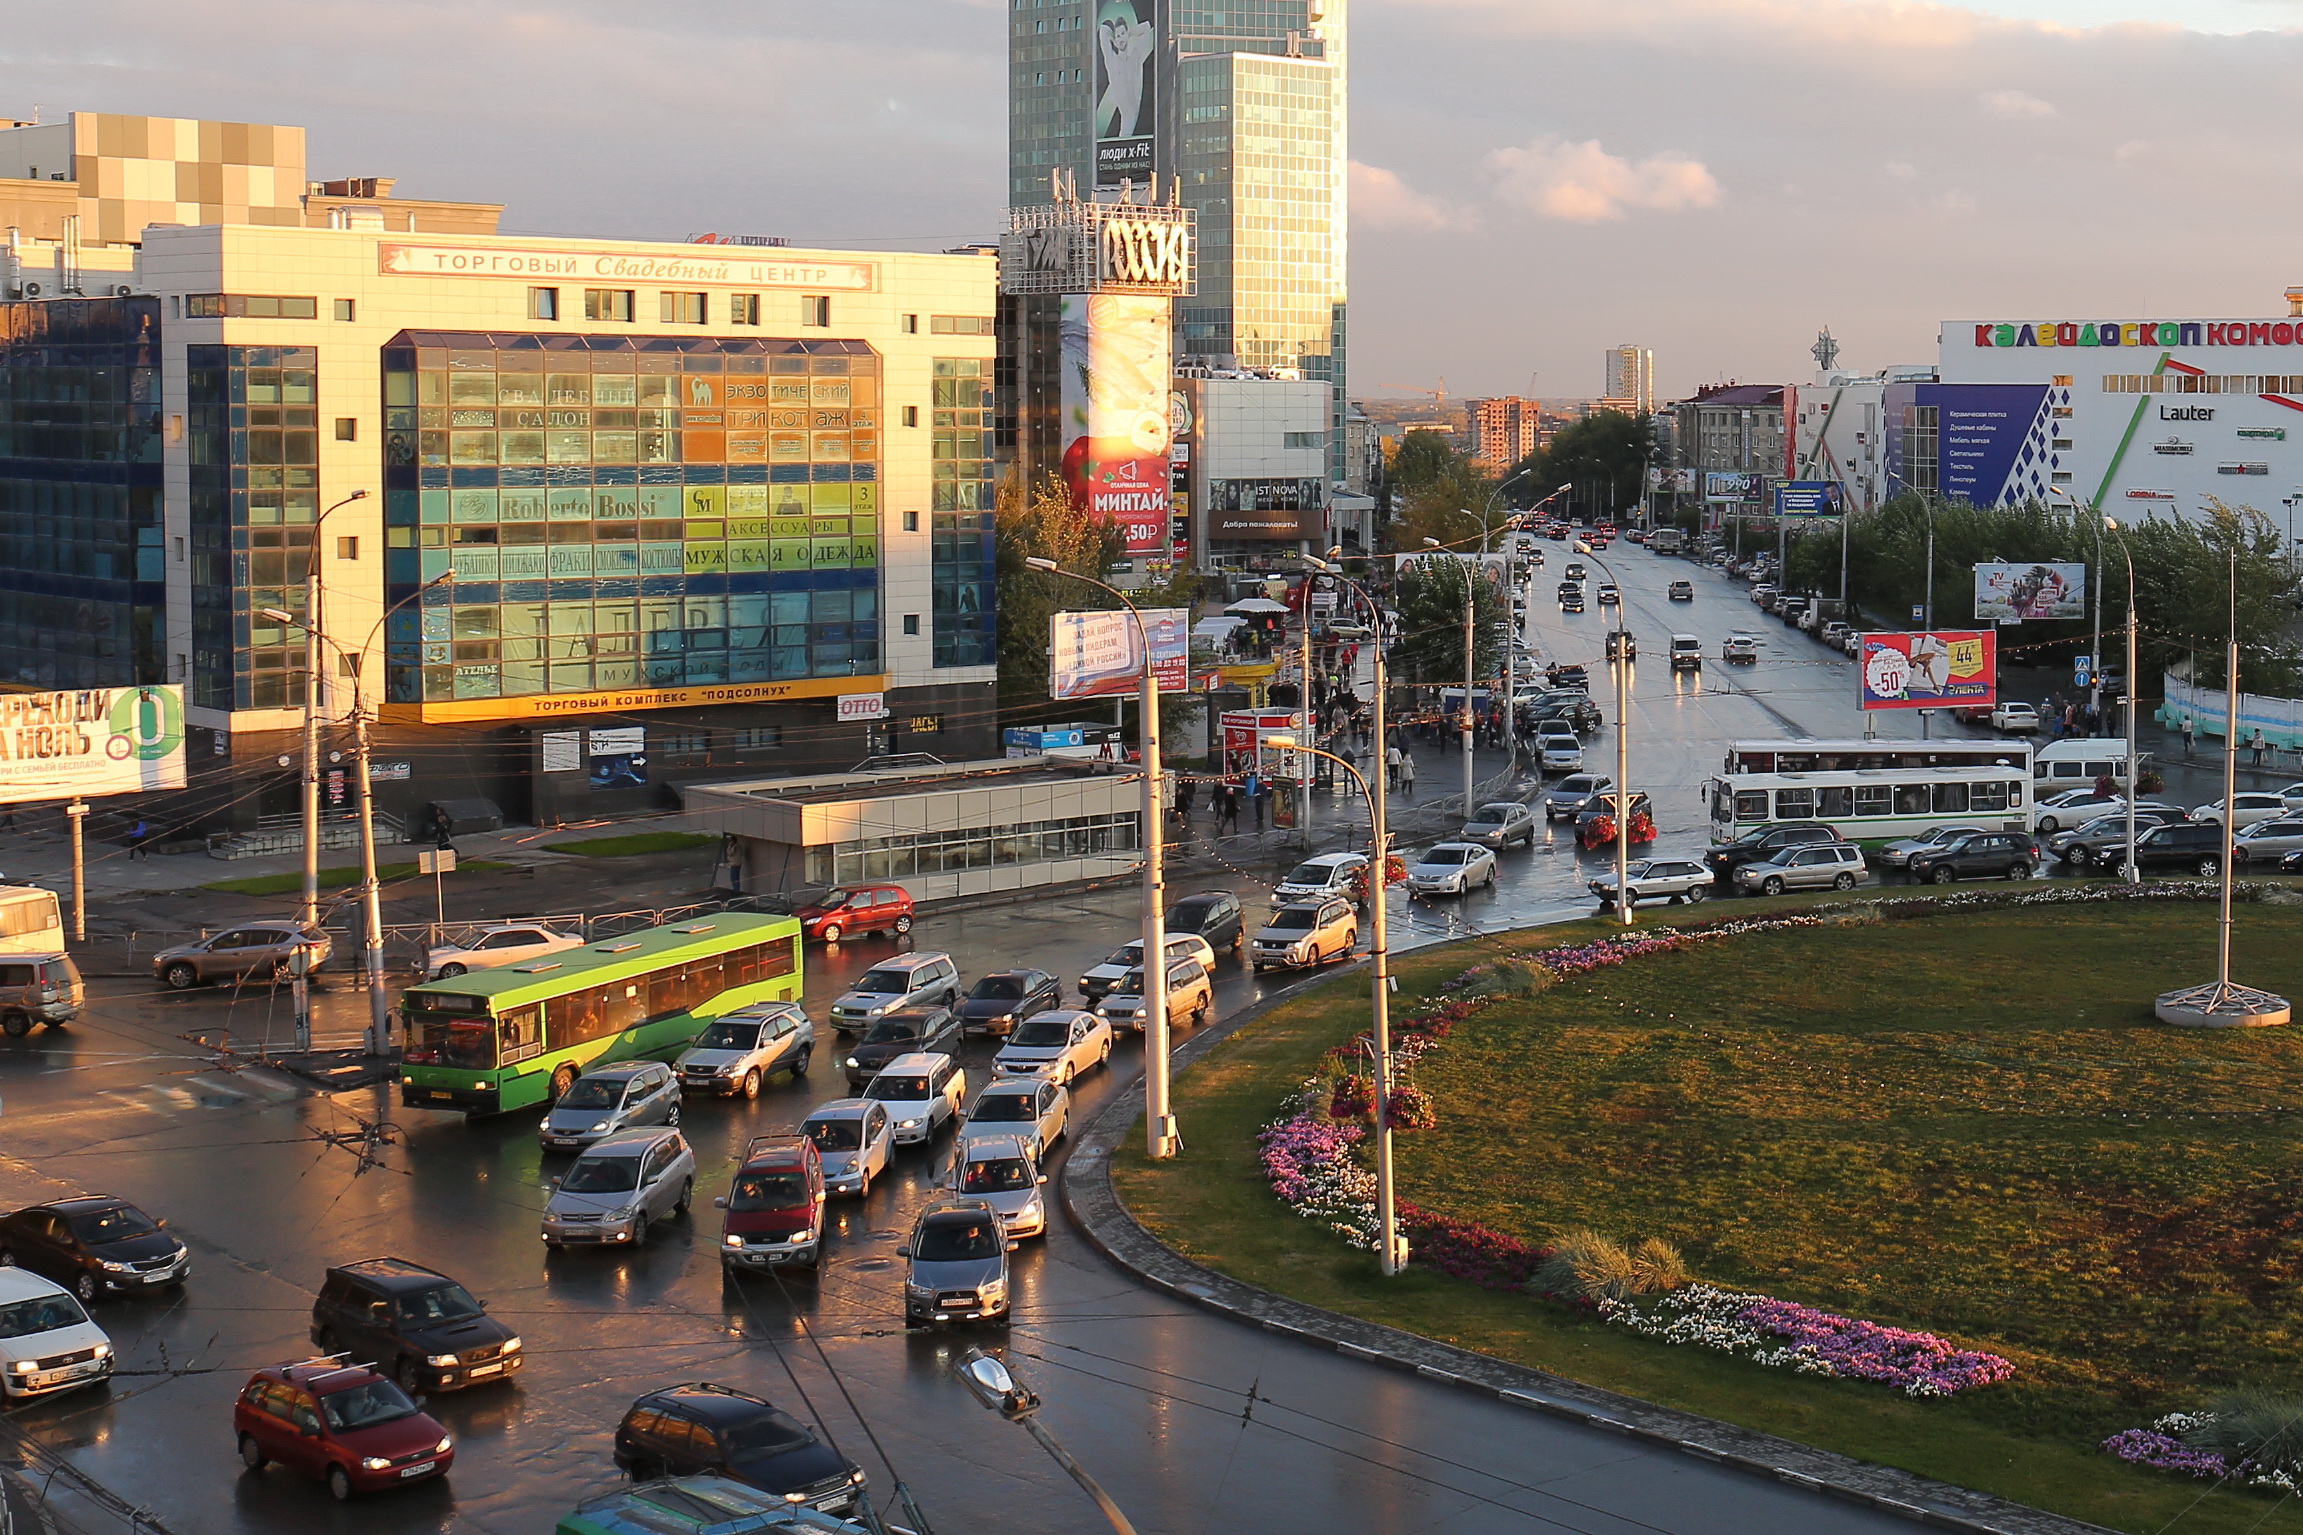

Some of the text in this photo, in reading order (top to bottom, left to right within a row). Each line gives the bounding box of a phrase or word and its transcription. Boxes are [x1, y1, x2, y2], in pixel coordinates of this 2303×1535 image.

[434, 254, 829, 284] ТОРГОВЫЙ Свадебный ЦЕНТР
[498, 387, 636, 405] СВАДЕБНЫЙ
[727, 383, 848, 399] ЭКЗОТИЧЕСКИЙ
[517, 411, 591, 426] САЛОН
[2160, 405, 2215, 421] Lauter
[860, 487, 868, 500] 3
[1272, 485, 1298, 495] NOVA
[501, 494, 657, 519] Roberto Bossi
[1094, 487, 1164, 512] МИНТАЙ
[728, 521, 833, 535] АКСЕССУАРЫ
[1223, 521, 1248, 529] Добро
[550, 550, 591, 572] ФРАКИ
[641, 547, 682, 569] КОСТЮМЫ
[686, 546, 875, 565] МУЖСКАЯ ОДЕЖДА
[1098, 622, 1123, 634] ВОПРОС
[1956, 646, 1972, 663] 44
[455, 664, 498, 676] АТЕЛЬЕ
[0, 690, 110, 727] РЕХОДИ
[534, 697, 609, 712] ТОРГОВЫЙ
[616, 692, 688, 706] КОМПЛЕКС
[841, 698, 880, 714] OTTO
[17, 726, 90, 759] НОЛЬ
[58, 760, 106, 771] БЕСПЛАТНО
